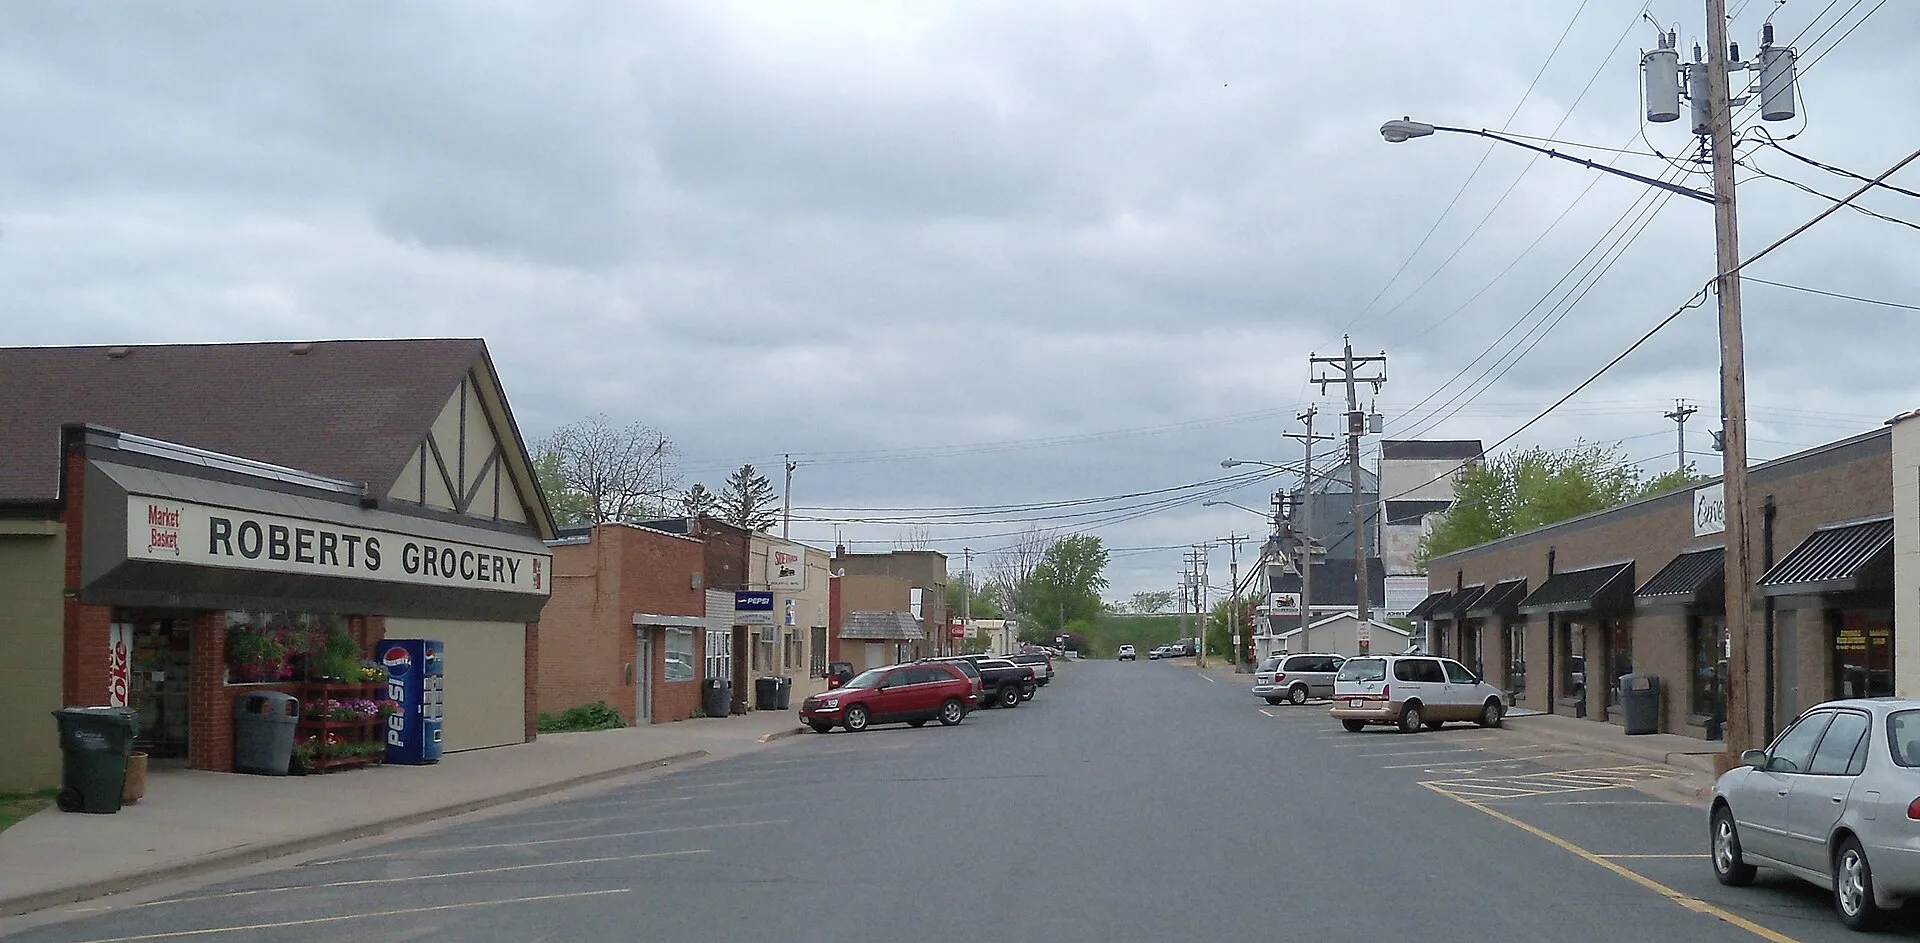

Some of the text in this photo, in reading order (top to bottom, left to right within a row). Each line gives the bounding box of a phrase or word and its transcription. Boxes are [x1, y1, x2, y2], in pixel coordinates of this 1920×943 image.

[148, 505, 179, 527] Market
[1697, 495, 1725, 528] Curve
[151, 528, 178, 548] Basket
[209, 516, 381, 571] ROBERTS
[402, 542, 521, 584] GROCERY
[113, 639, 127, 707] oke
[388, 678, 404, 747] PESI
